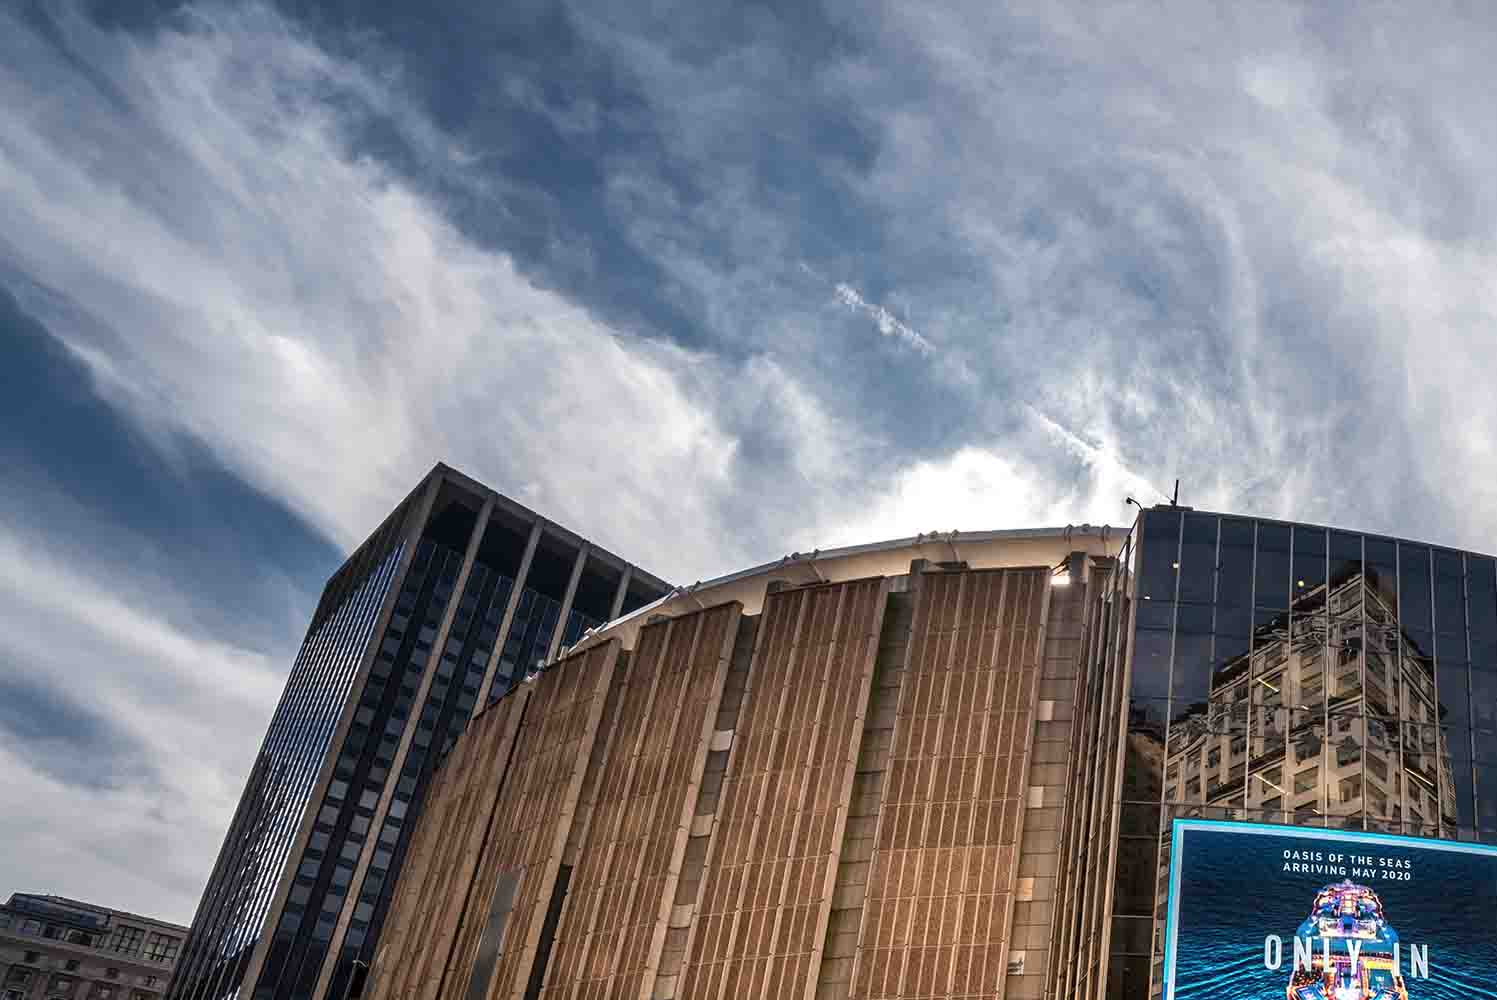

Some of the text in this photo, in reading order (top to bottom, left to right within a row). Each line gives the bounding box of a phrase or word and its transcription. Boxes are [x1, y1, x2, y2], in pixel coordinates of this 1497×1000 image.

[1283, 849, 1411, 869] OASIS OF THE SEAS
[1283, 862, 1411, 881] ARRIVING MAY 2020
[1264, 934, 1428, 980] ONLY IN
